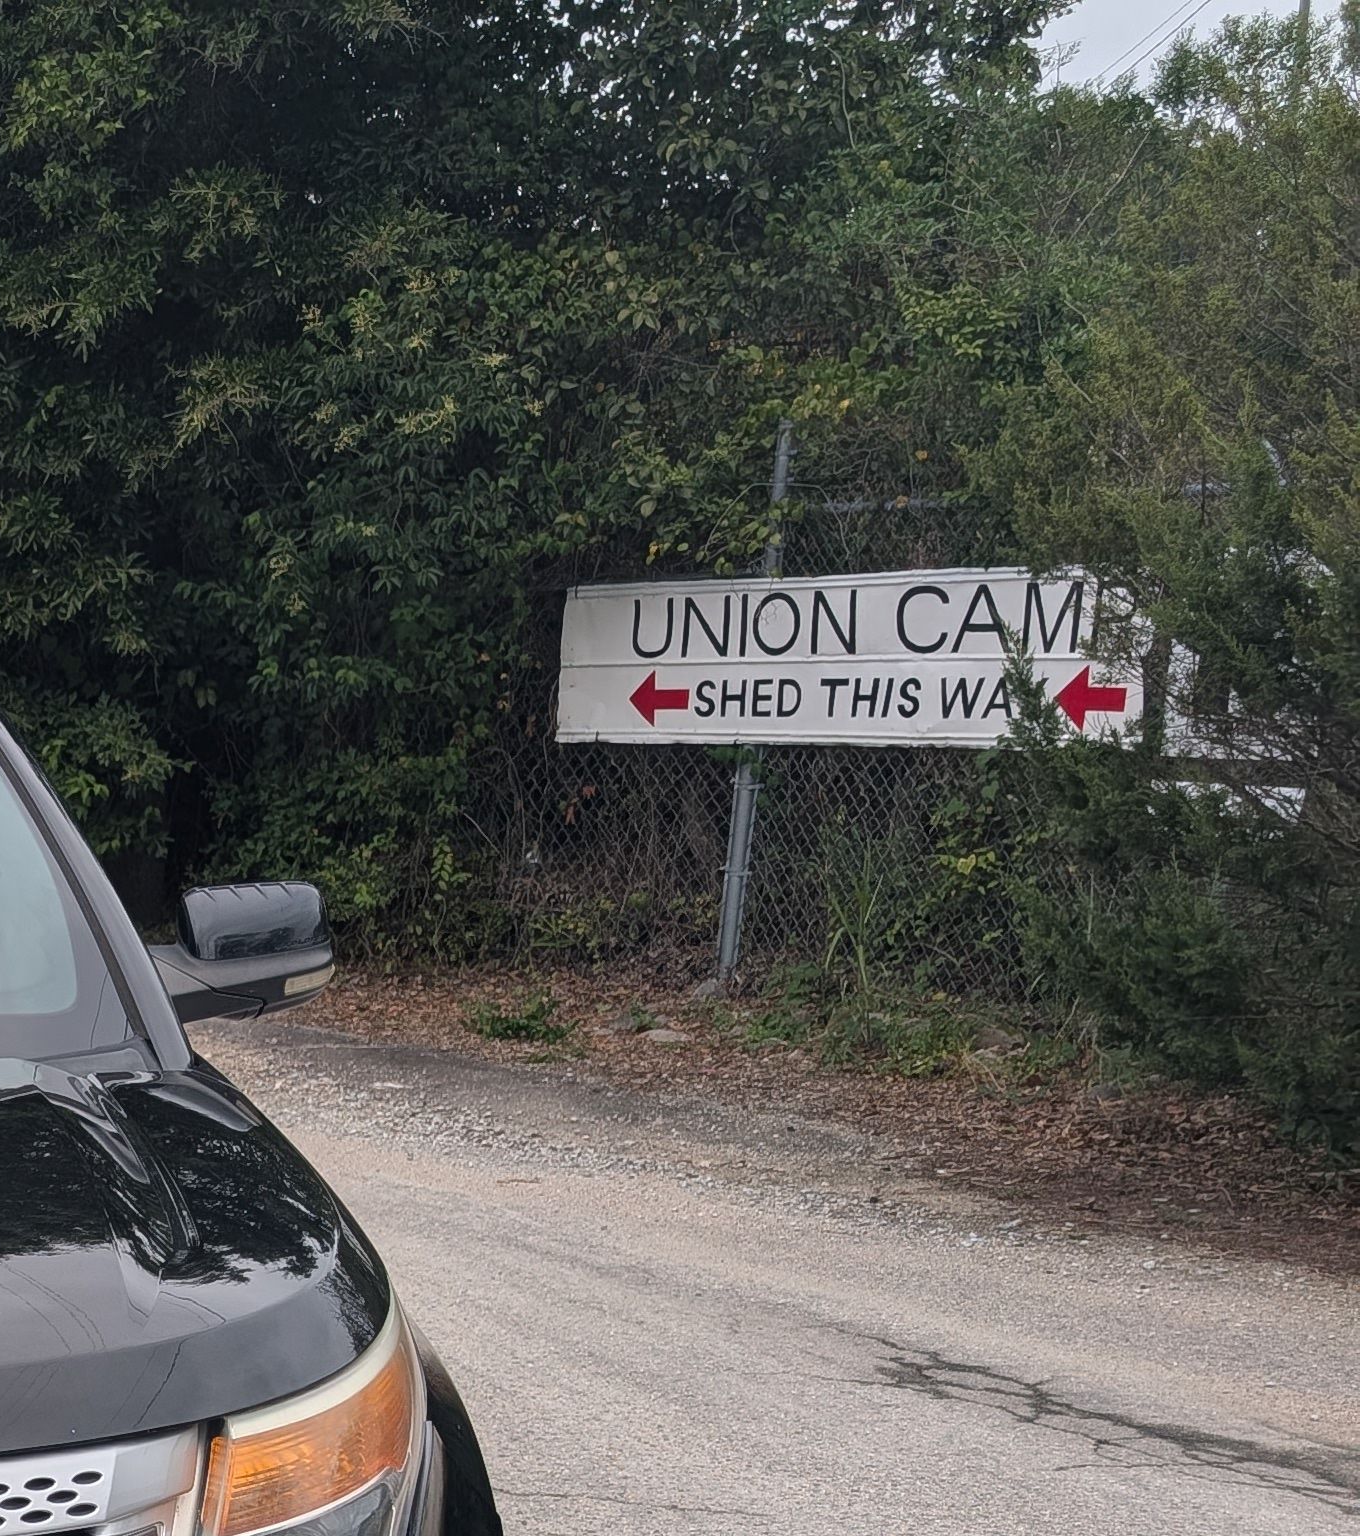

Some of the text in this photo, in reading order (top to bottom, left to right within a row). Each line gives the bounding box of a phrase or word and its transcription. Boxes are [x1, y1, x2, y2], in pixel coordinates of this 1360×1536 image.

[631, 588, 858, 658] UNION
[694, 676, 1049, 720] SHED THIS WA
